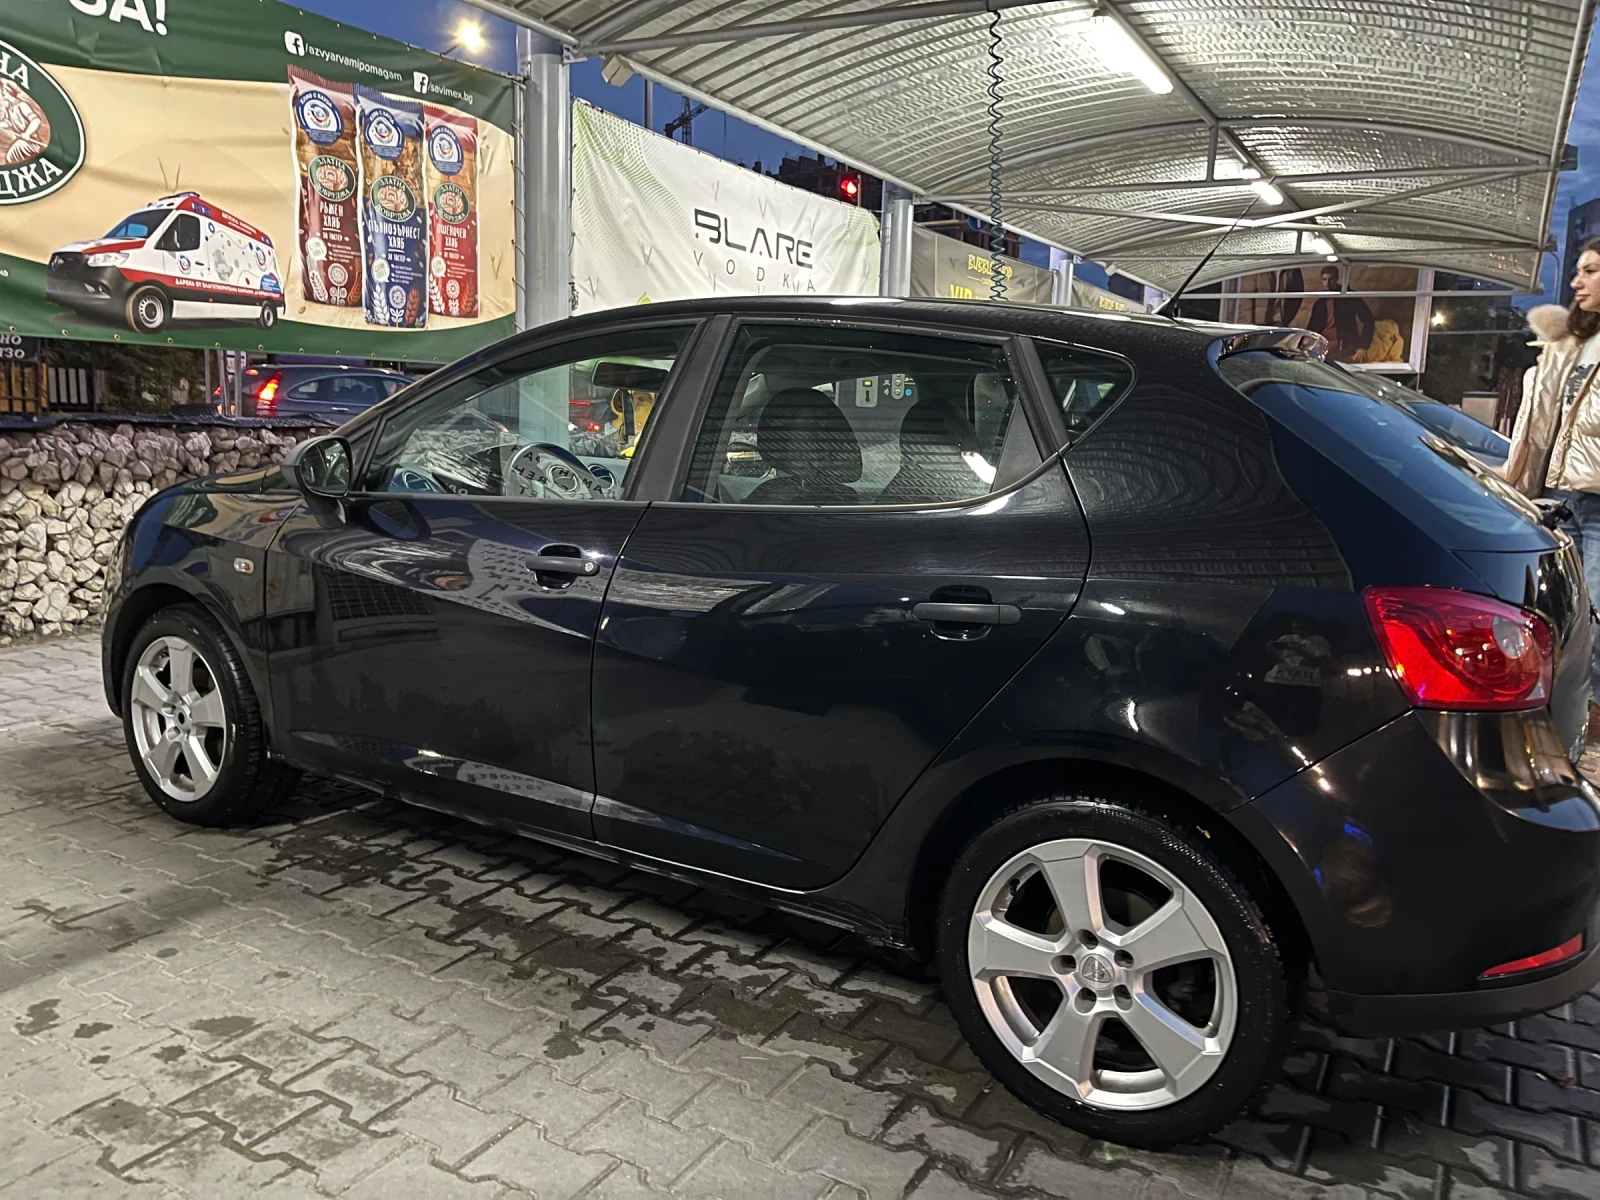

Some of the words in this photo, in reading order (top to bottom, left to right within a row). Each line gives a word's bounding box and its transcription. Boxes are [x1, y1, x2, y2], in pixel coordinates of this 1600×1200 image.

[305, 43, 403, 82] /azvyarvamipomagam
[427, 81, 474, 105] /savimex.bg
[319, 200, 344, 217] РЪЖЕН
[322, 214, 341, 229] ХЛЯБ
[369, 220, 420, 240] ПЪЛНОЗЪРНЕСТ
[388, 235, 405, 250] ХЛЯБ
[694, 208, 813, 269] BLARE
[693, 250, 816, 293] VODKA
